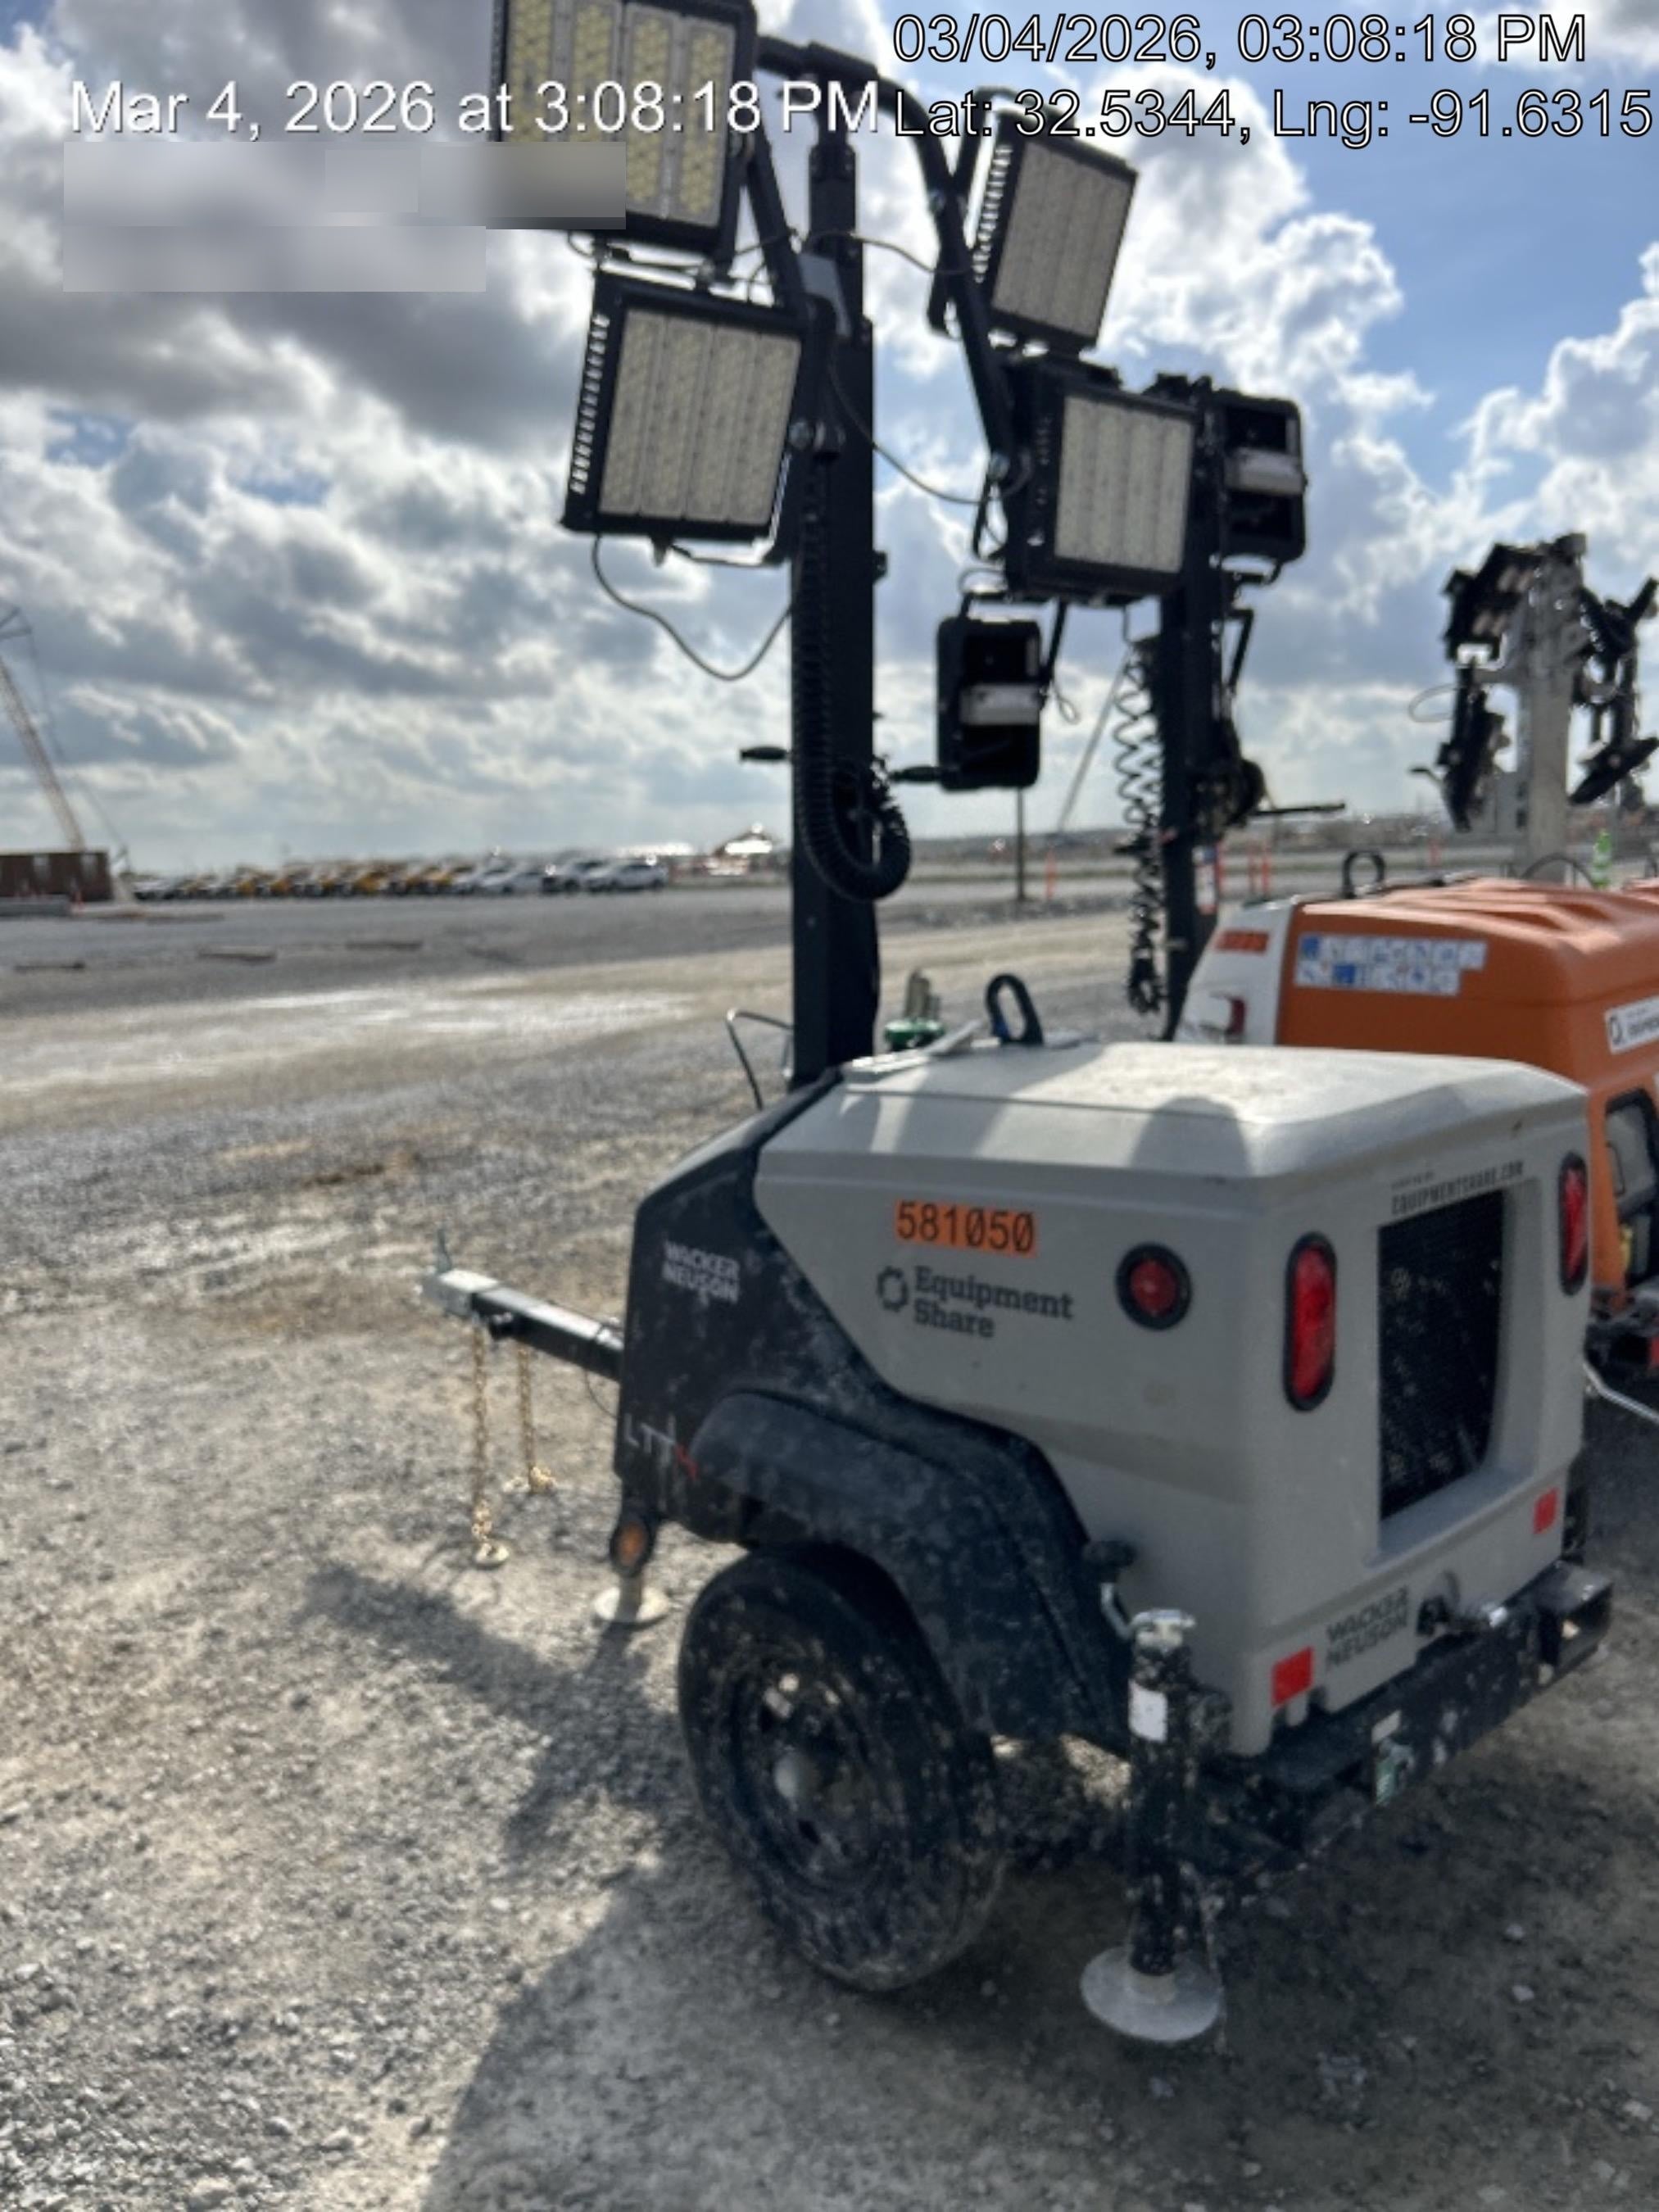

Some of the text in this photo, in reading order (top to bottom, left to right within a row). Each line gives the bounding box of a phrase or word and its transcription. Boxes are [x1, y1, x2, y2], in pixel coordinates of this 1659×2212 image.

[897, 1202, 1034, 1253] 581050
[913, 1298, 995, 1337] Share
[914, 1267, 1073, 1319] Equipment
